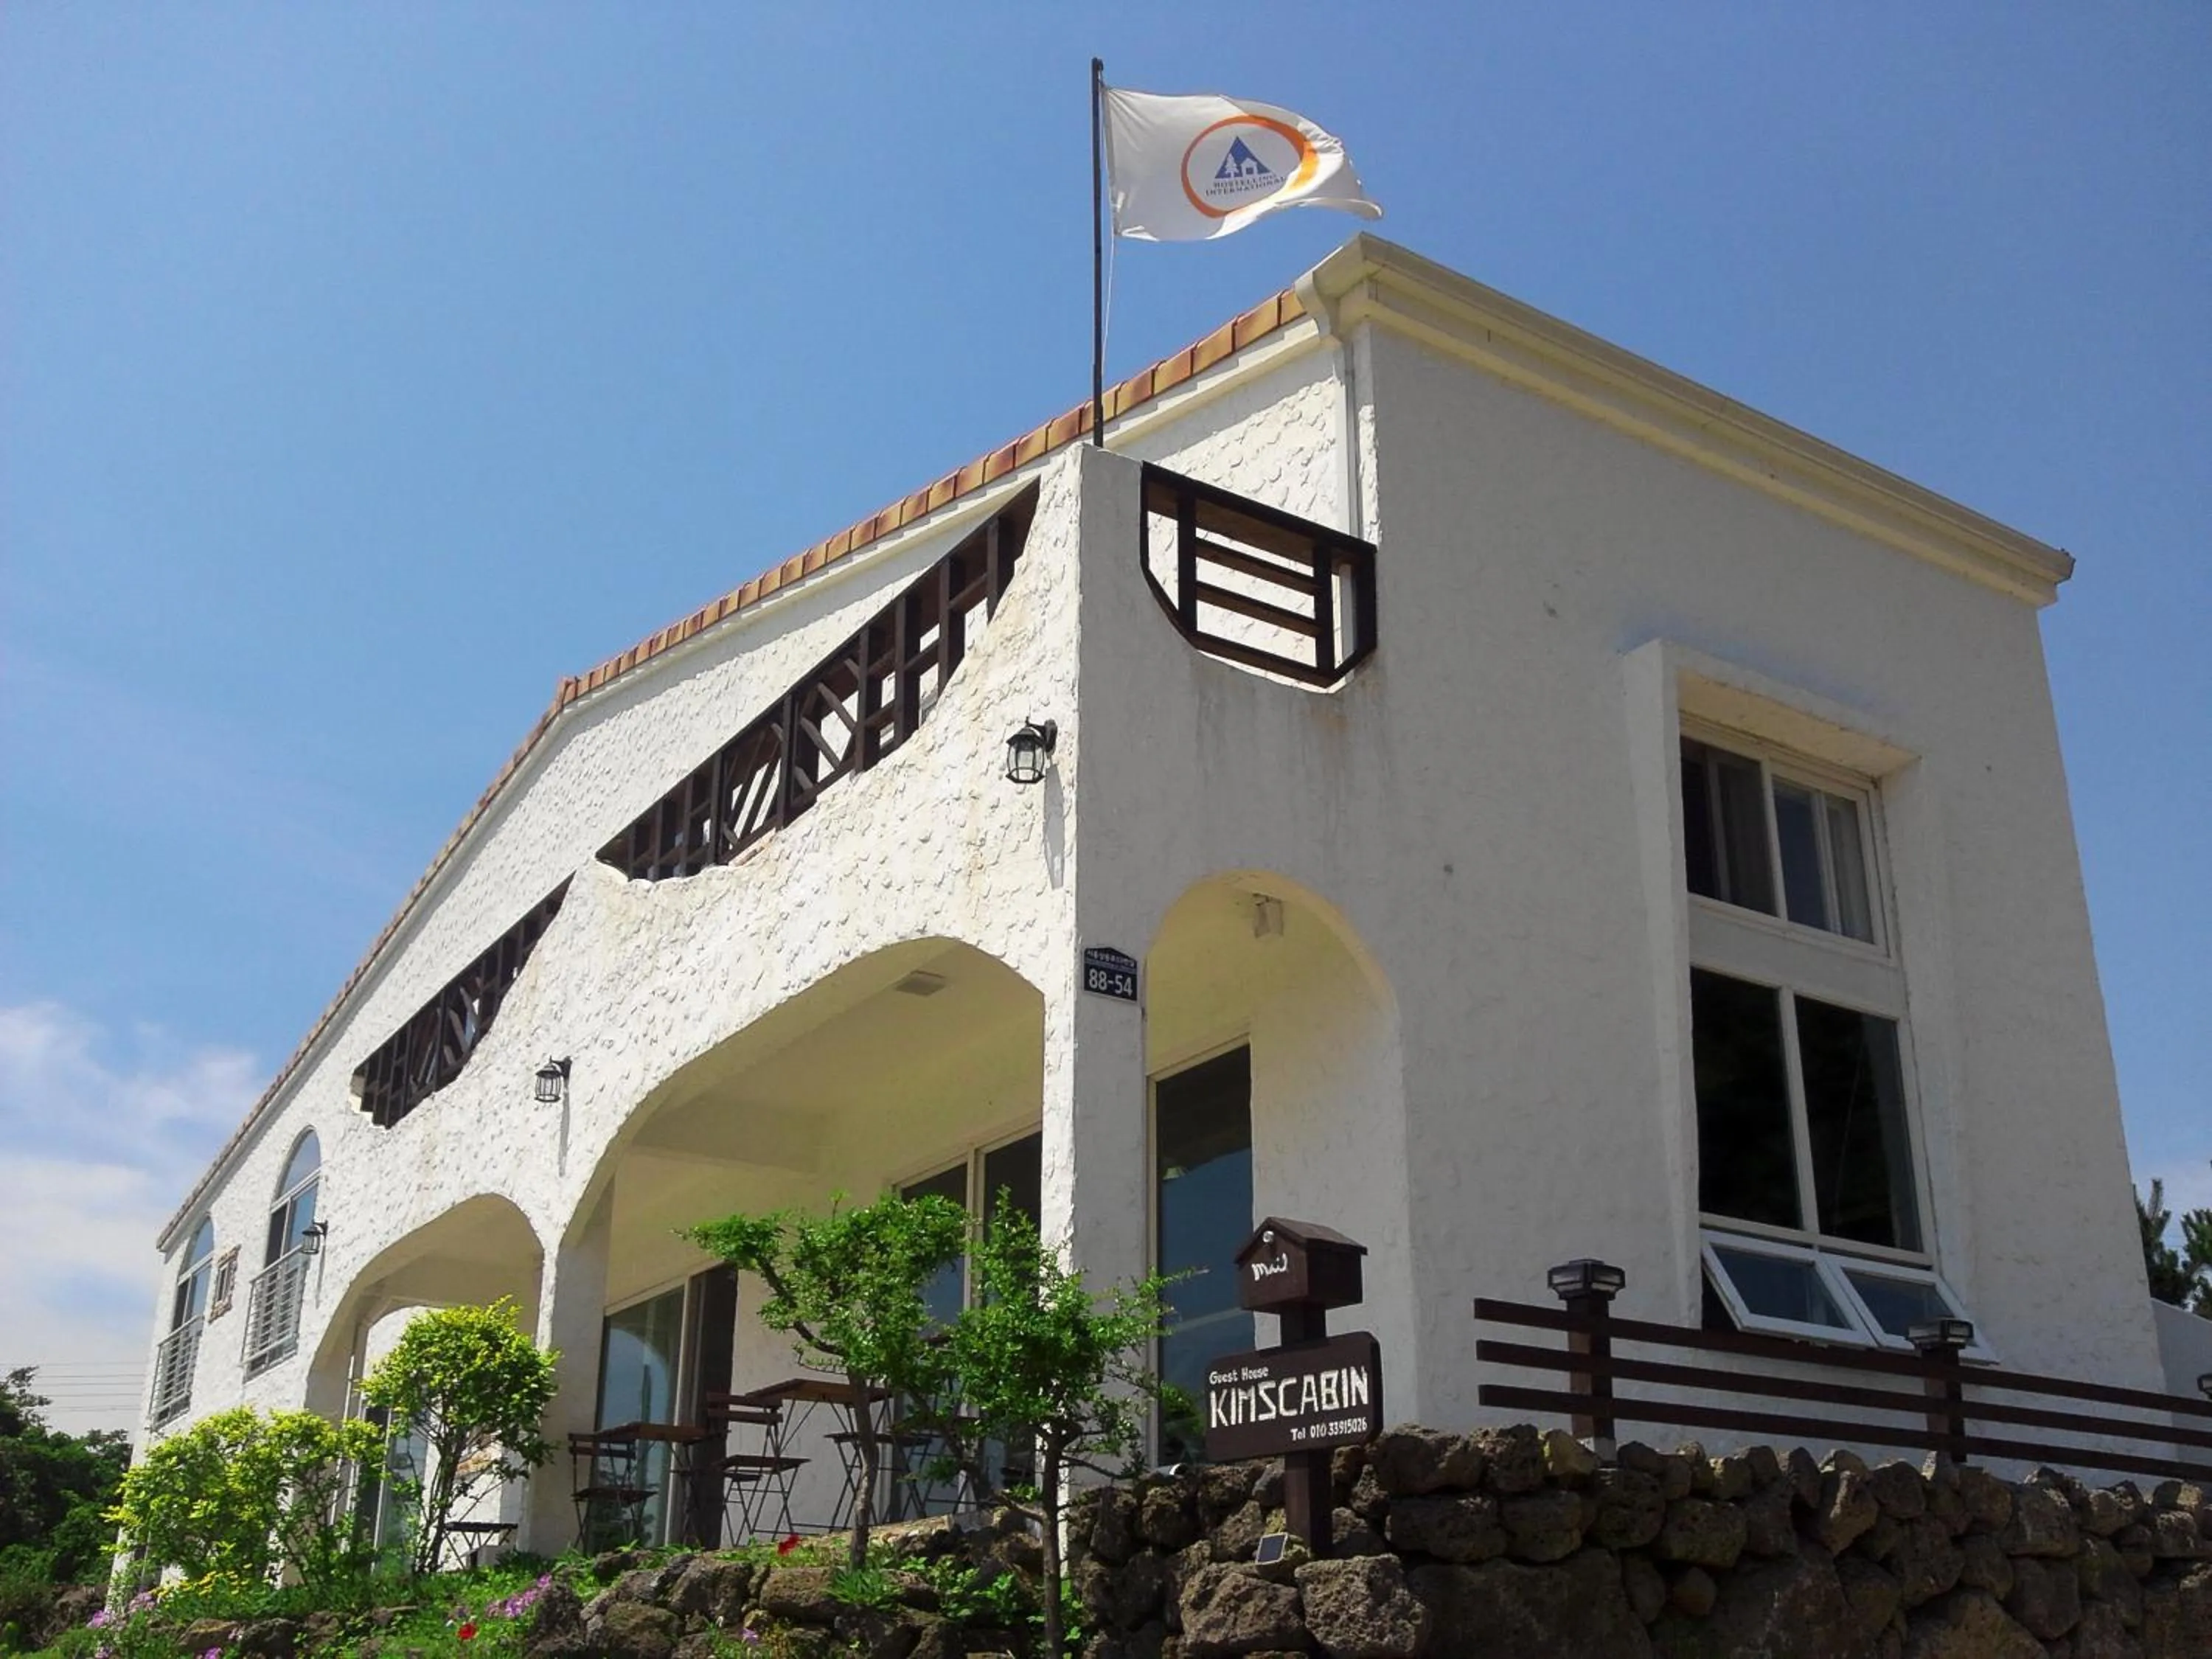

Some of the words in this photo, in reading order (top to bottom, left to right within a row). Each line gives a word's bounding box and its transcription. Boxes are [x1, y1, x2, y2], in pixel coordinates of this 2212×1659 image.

[1205, 176, 1286, 196] INTERNATIONAL
[1089, 968, 1133, 997] 88-54
[1209, 1369, 1237, 1385] Guest
[1241, 1366, 1269, 1381] House
[1209, 1366, 1369, 1428] KIMSCABIN
[1290, 1427, 1306, 1441] Tel
